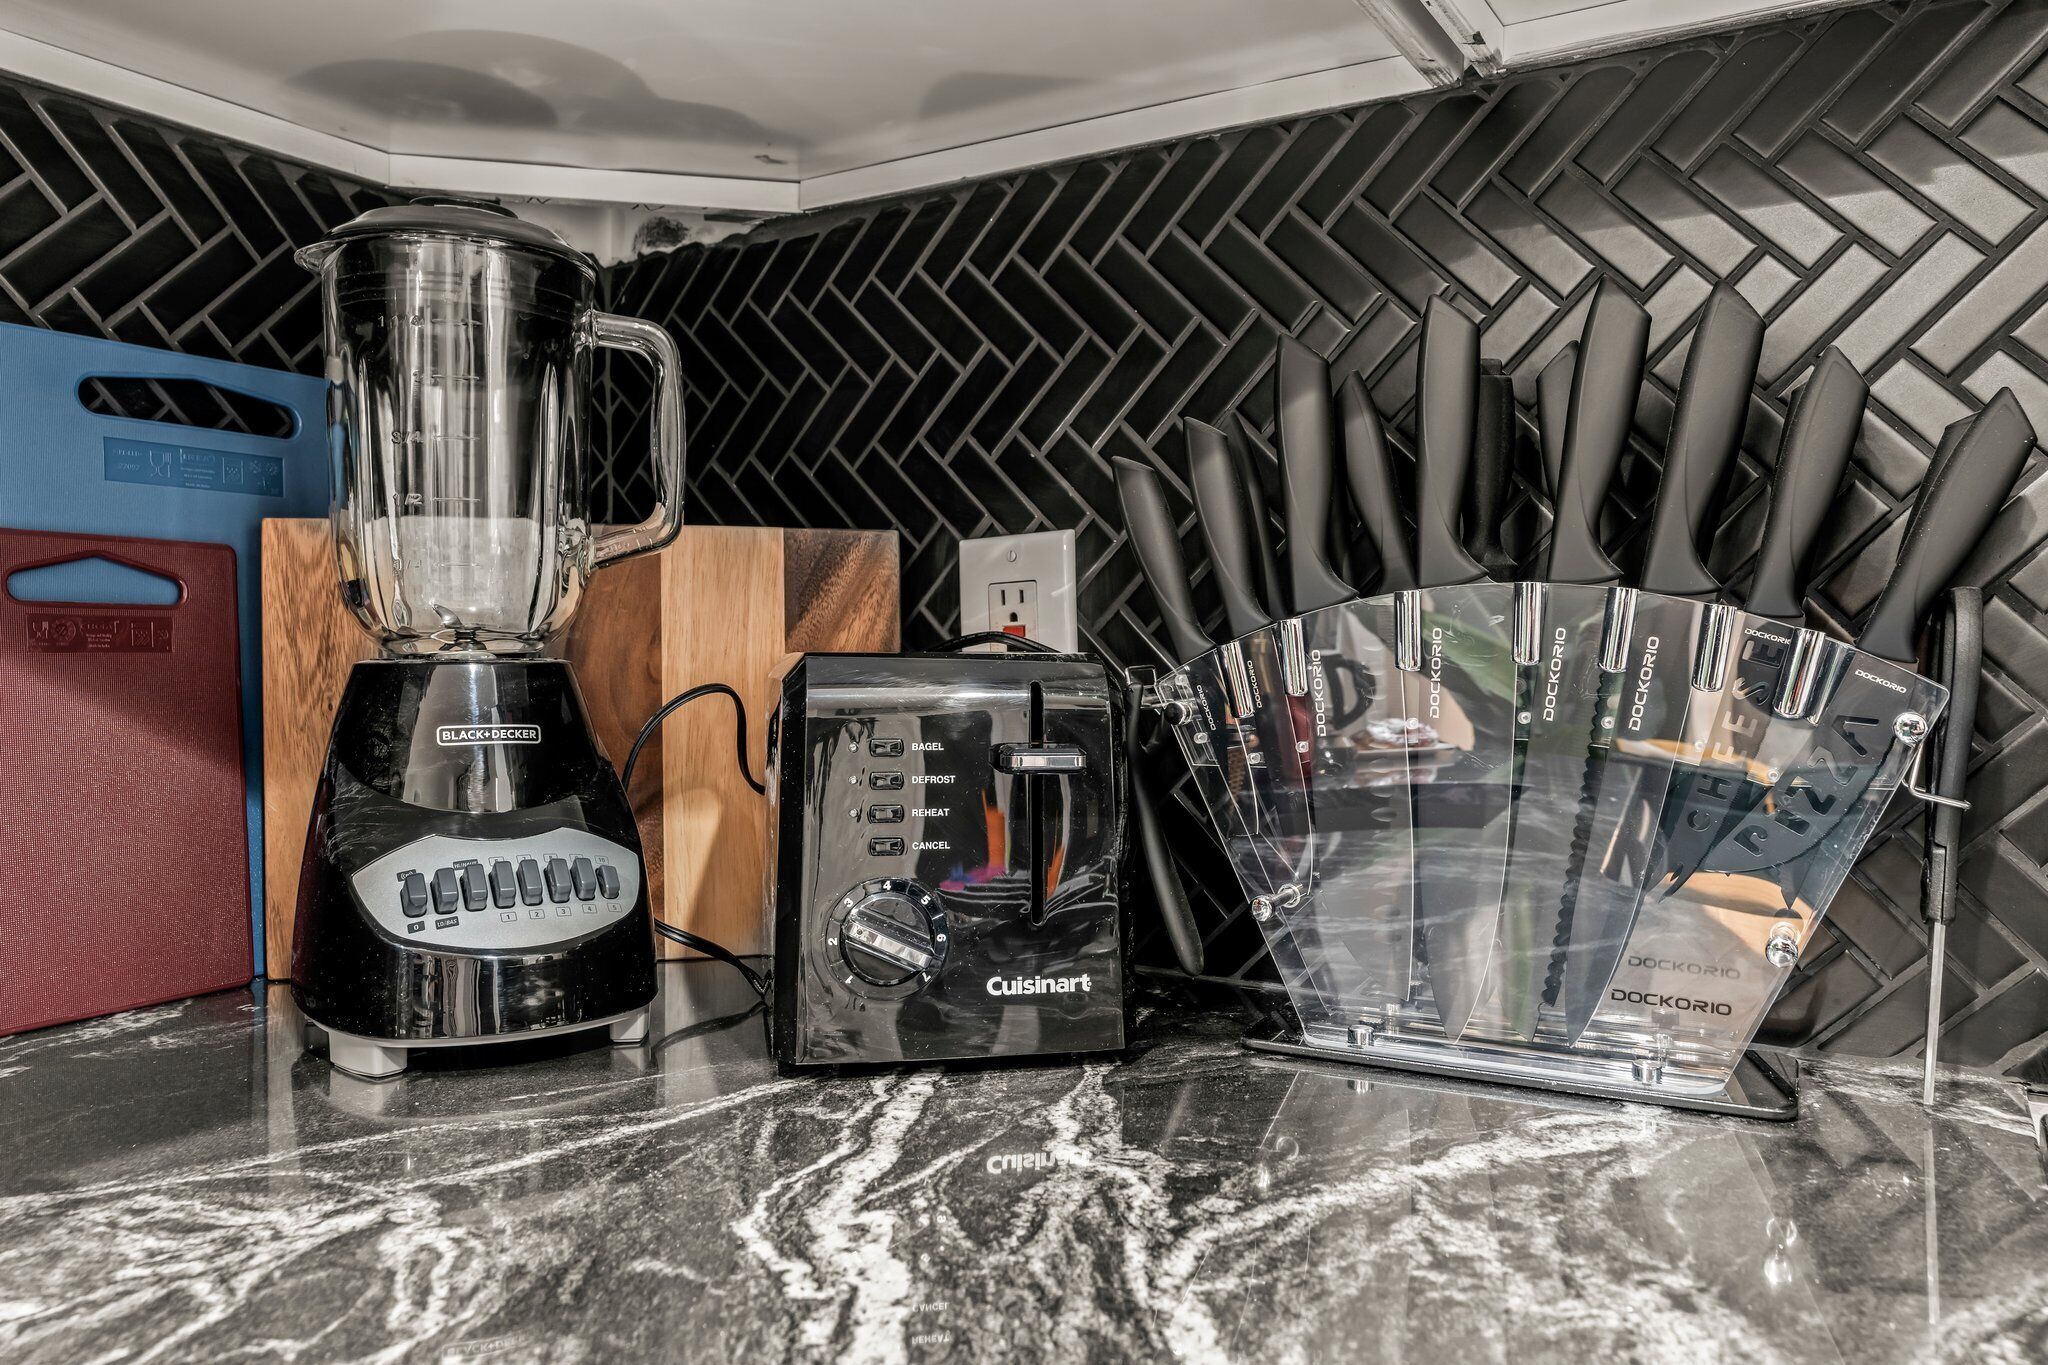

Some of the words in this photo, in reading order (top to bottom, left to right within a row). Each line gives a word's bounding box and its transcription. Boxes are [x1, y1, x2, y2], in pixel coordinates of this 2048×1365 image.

[1429, 627, 1443, 719] DOCKORIO
[1542, 627, 1567, 722] DOCKORIO
[1246, 659, 1263, 709] DOCKORIO
[1628, 635, 1660, 733] DOCKORIO
[1854, 668, 1908, 695] DOCKORIO
[1311, 649, 1327, 738] DOCKORIO
[1196, 684, 1217, 731] DOCKORIO
[442, 729, 537, 741] BLACK+DECKER
[1686, 639, 1786, 833] CHEESE
[911, 742, 944, 752] BAGEL
[911, 775, 956, 784] DEFROST
[911, 808, 950, 817] REHEAT
[911, 841, 950, 850] CANCEL
[882, 880, 892, 891] 4
[843, 897, 854, 908] 3
[920, 894, 932, 906] 5
[827, 937, 838, 946] 2
[936, 933, 947, 943] 6
[1627, 955, 1741, 980] DOCKORIO
[844, 975, 854, 984] 1
[921, 972, 932, 983] 7
[986, 974, 1092, 996] Cuisinart
[1610, 988, 1732, 1016] DOCKORIO
